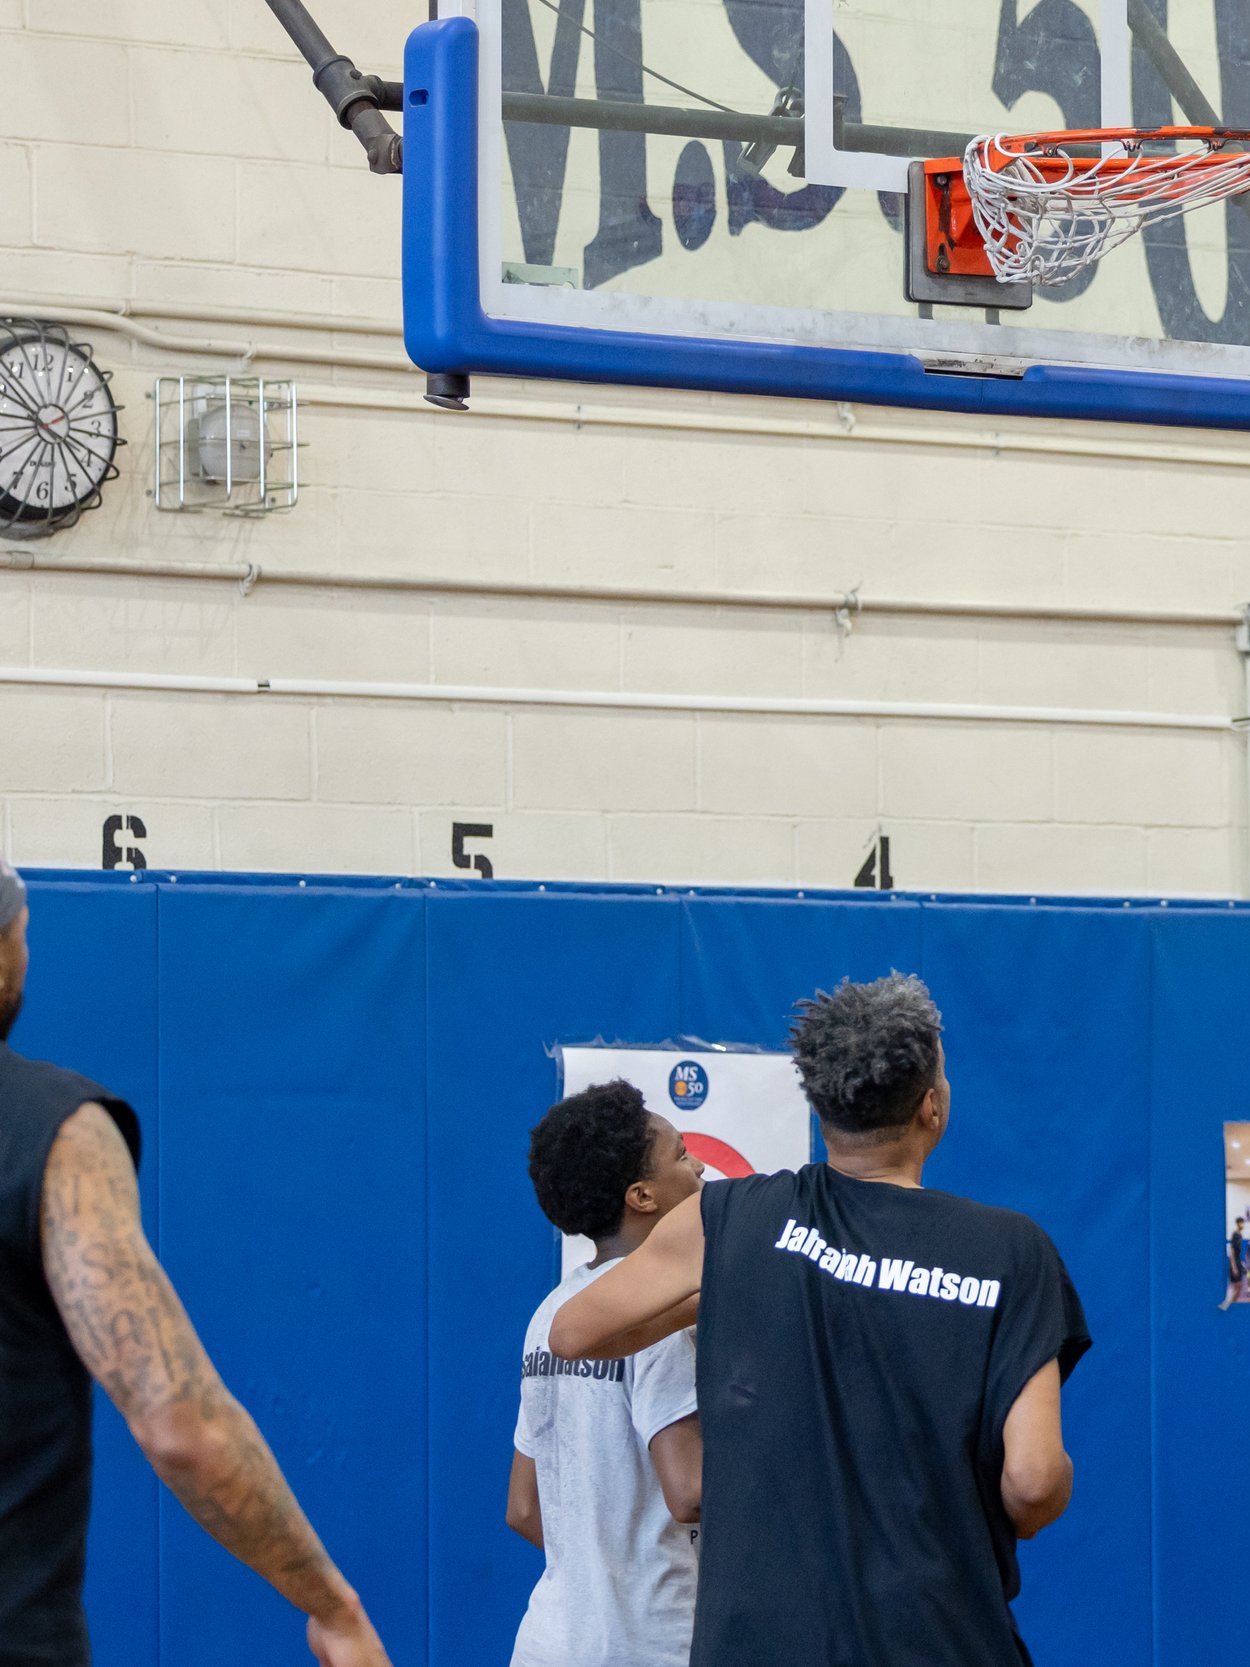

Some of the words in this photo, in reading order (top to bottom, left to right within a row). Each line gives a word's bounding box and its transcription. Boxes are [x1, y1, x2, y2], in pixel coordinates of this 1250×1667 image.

[89, 420, 101, 439] 3
[80, 450, 93, 468] 4
[36, 482, 49, 500] 6
[102, 814, 147, 869] 6
[452, 822, 493, 879] 5
[853, 836, 893, 889] 4
[675, 1066, 699, 1081] MS
[687, 1081, 704, 1097] 50
[878, 1258, 1001, 1308] Watson
